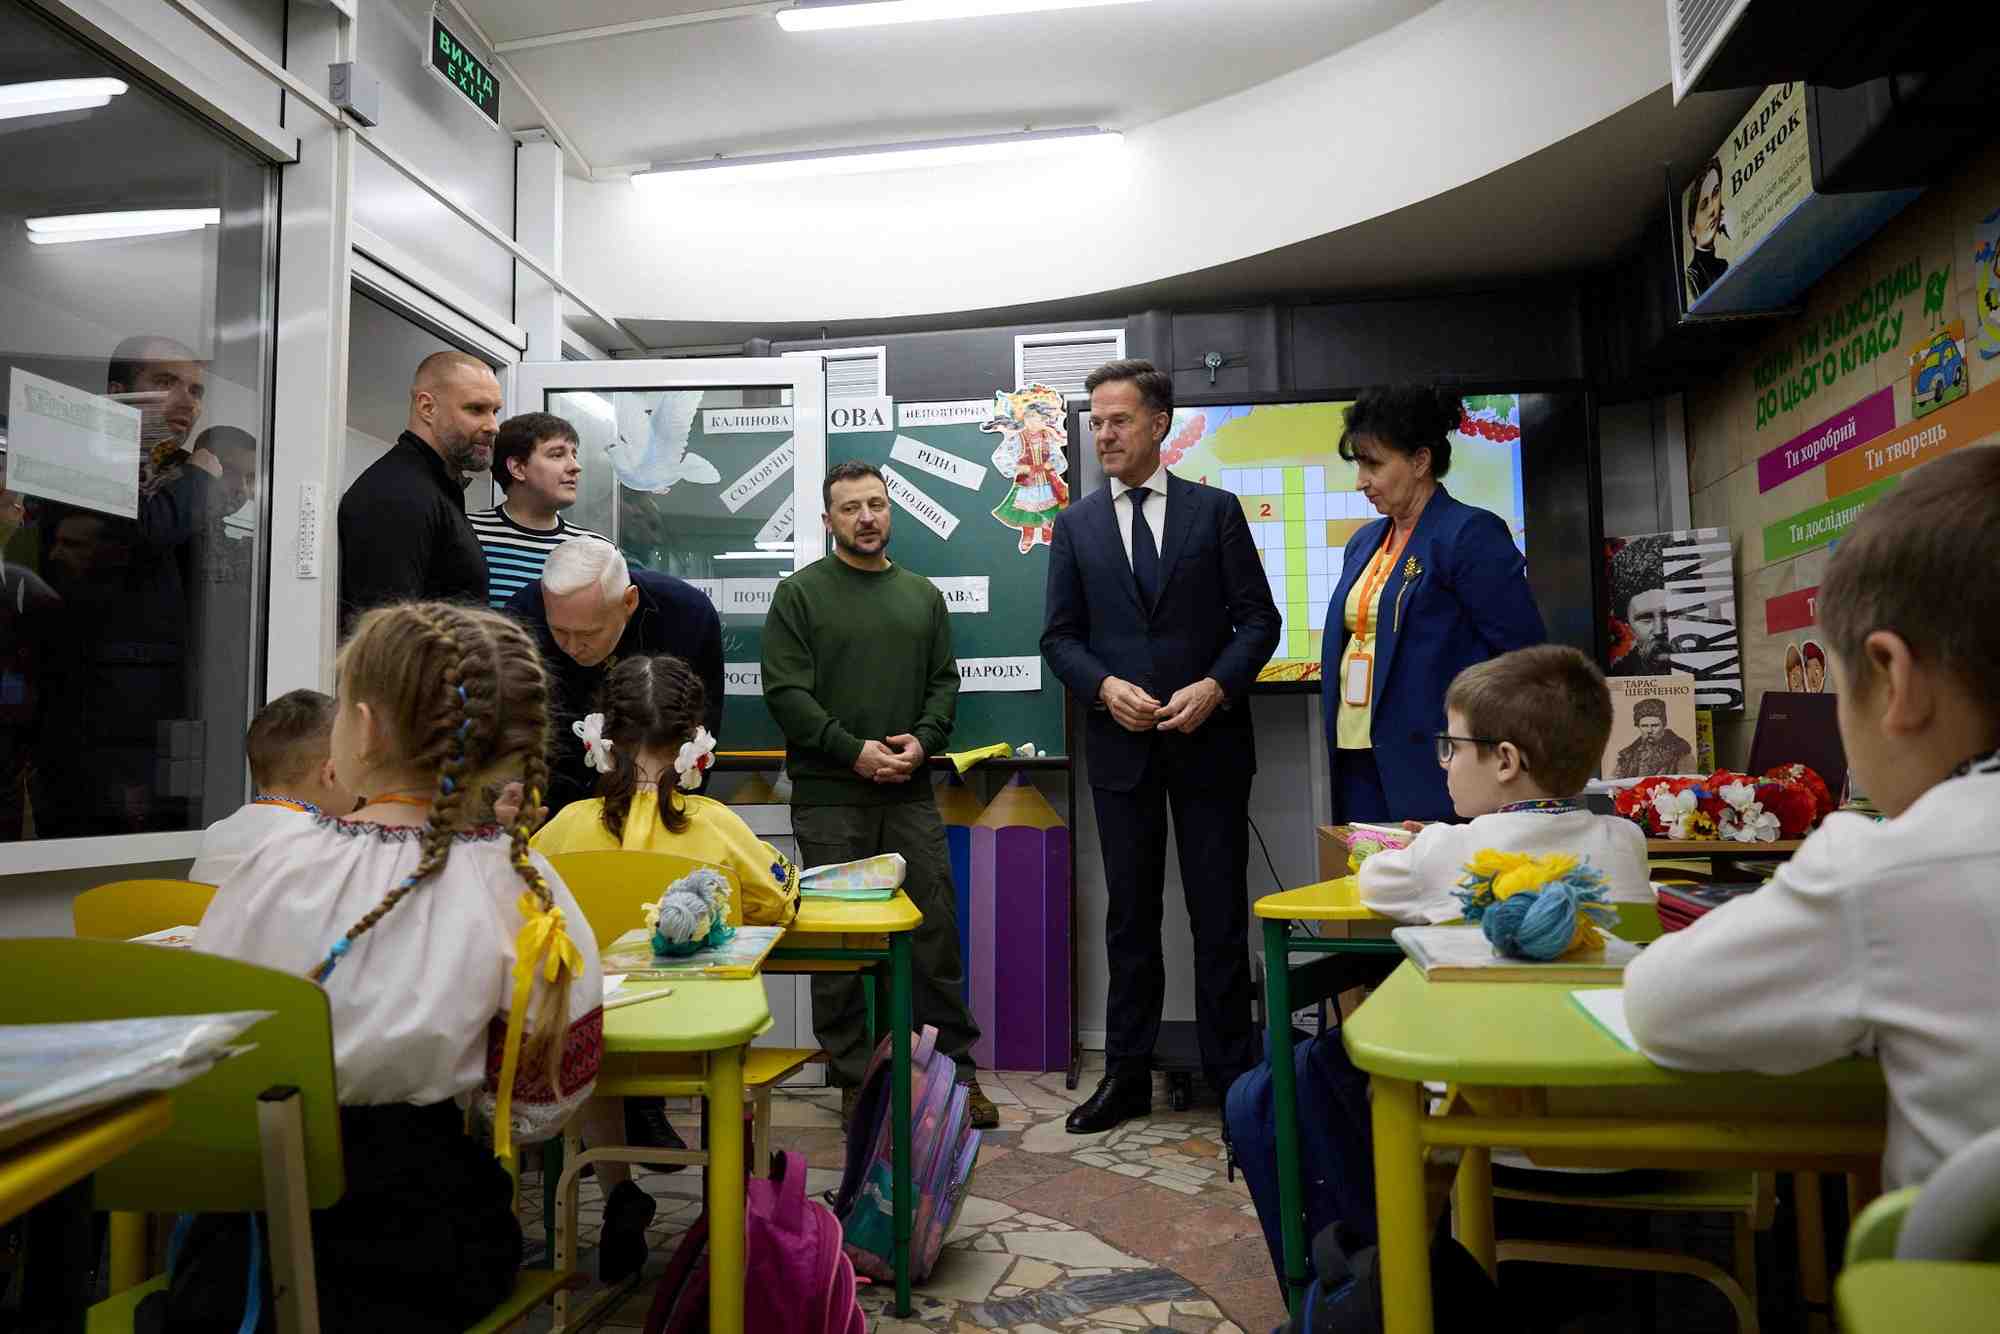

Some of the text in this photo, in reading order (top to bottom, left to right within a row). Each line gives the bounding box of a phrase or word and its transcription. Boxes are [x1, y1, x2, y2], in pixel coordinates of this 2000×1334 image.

[440, 31, 493, 97] ВИХІД
[447, 62, 483, 104] EXIT
[1733, 81, 1794, 160] Марко
[1731, 108, 1801, 198] Вовчок
[1823, 256, 1922, 347] ЗАХОДИШ
[1756, 310, 1904, 432] ДО ЦЬОГО КЛАСУ
[711, 414, 790, 428] КАЛИНОВА
[917, 449, 959, 475] РІДНА
[1785, 416, 1857, 469] Ти хоробрий
[1864, 423, 1947, 471] Ти творець
[1260, 503, 1272, 517] 2
[1789, 524, 1804, 543] Ти
[961, 664, 1029, 678] НАРОДУ.
[1624, 680, 1657, 689] ТАРАС
[1625, 686, 1689, 697] ШЕВЧЕНКО
